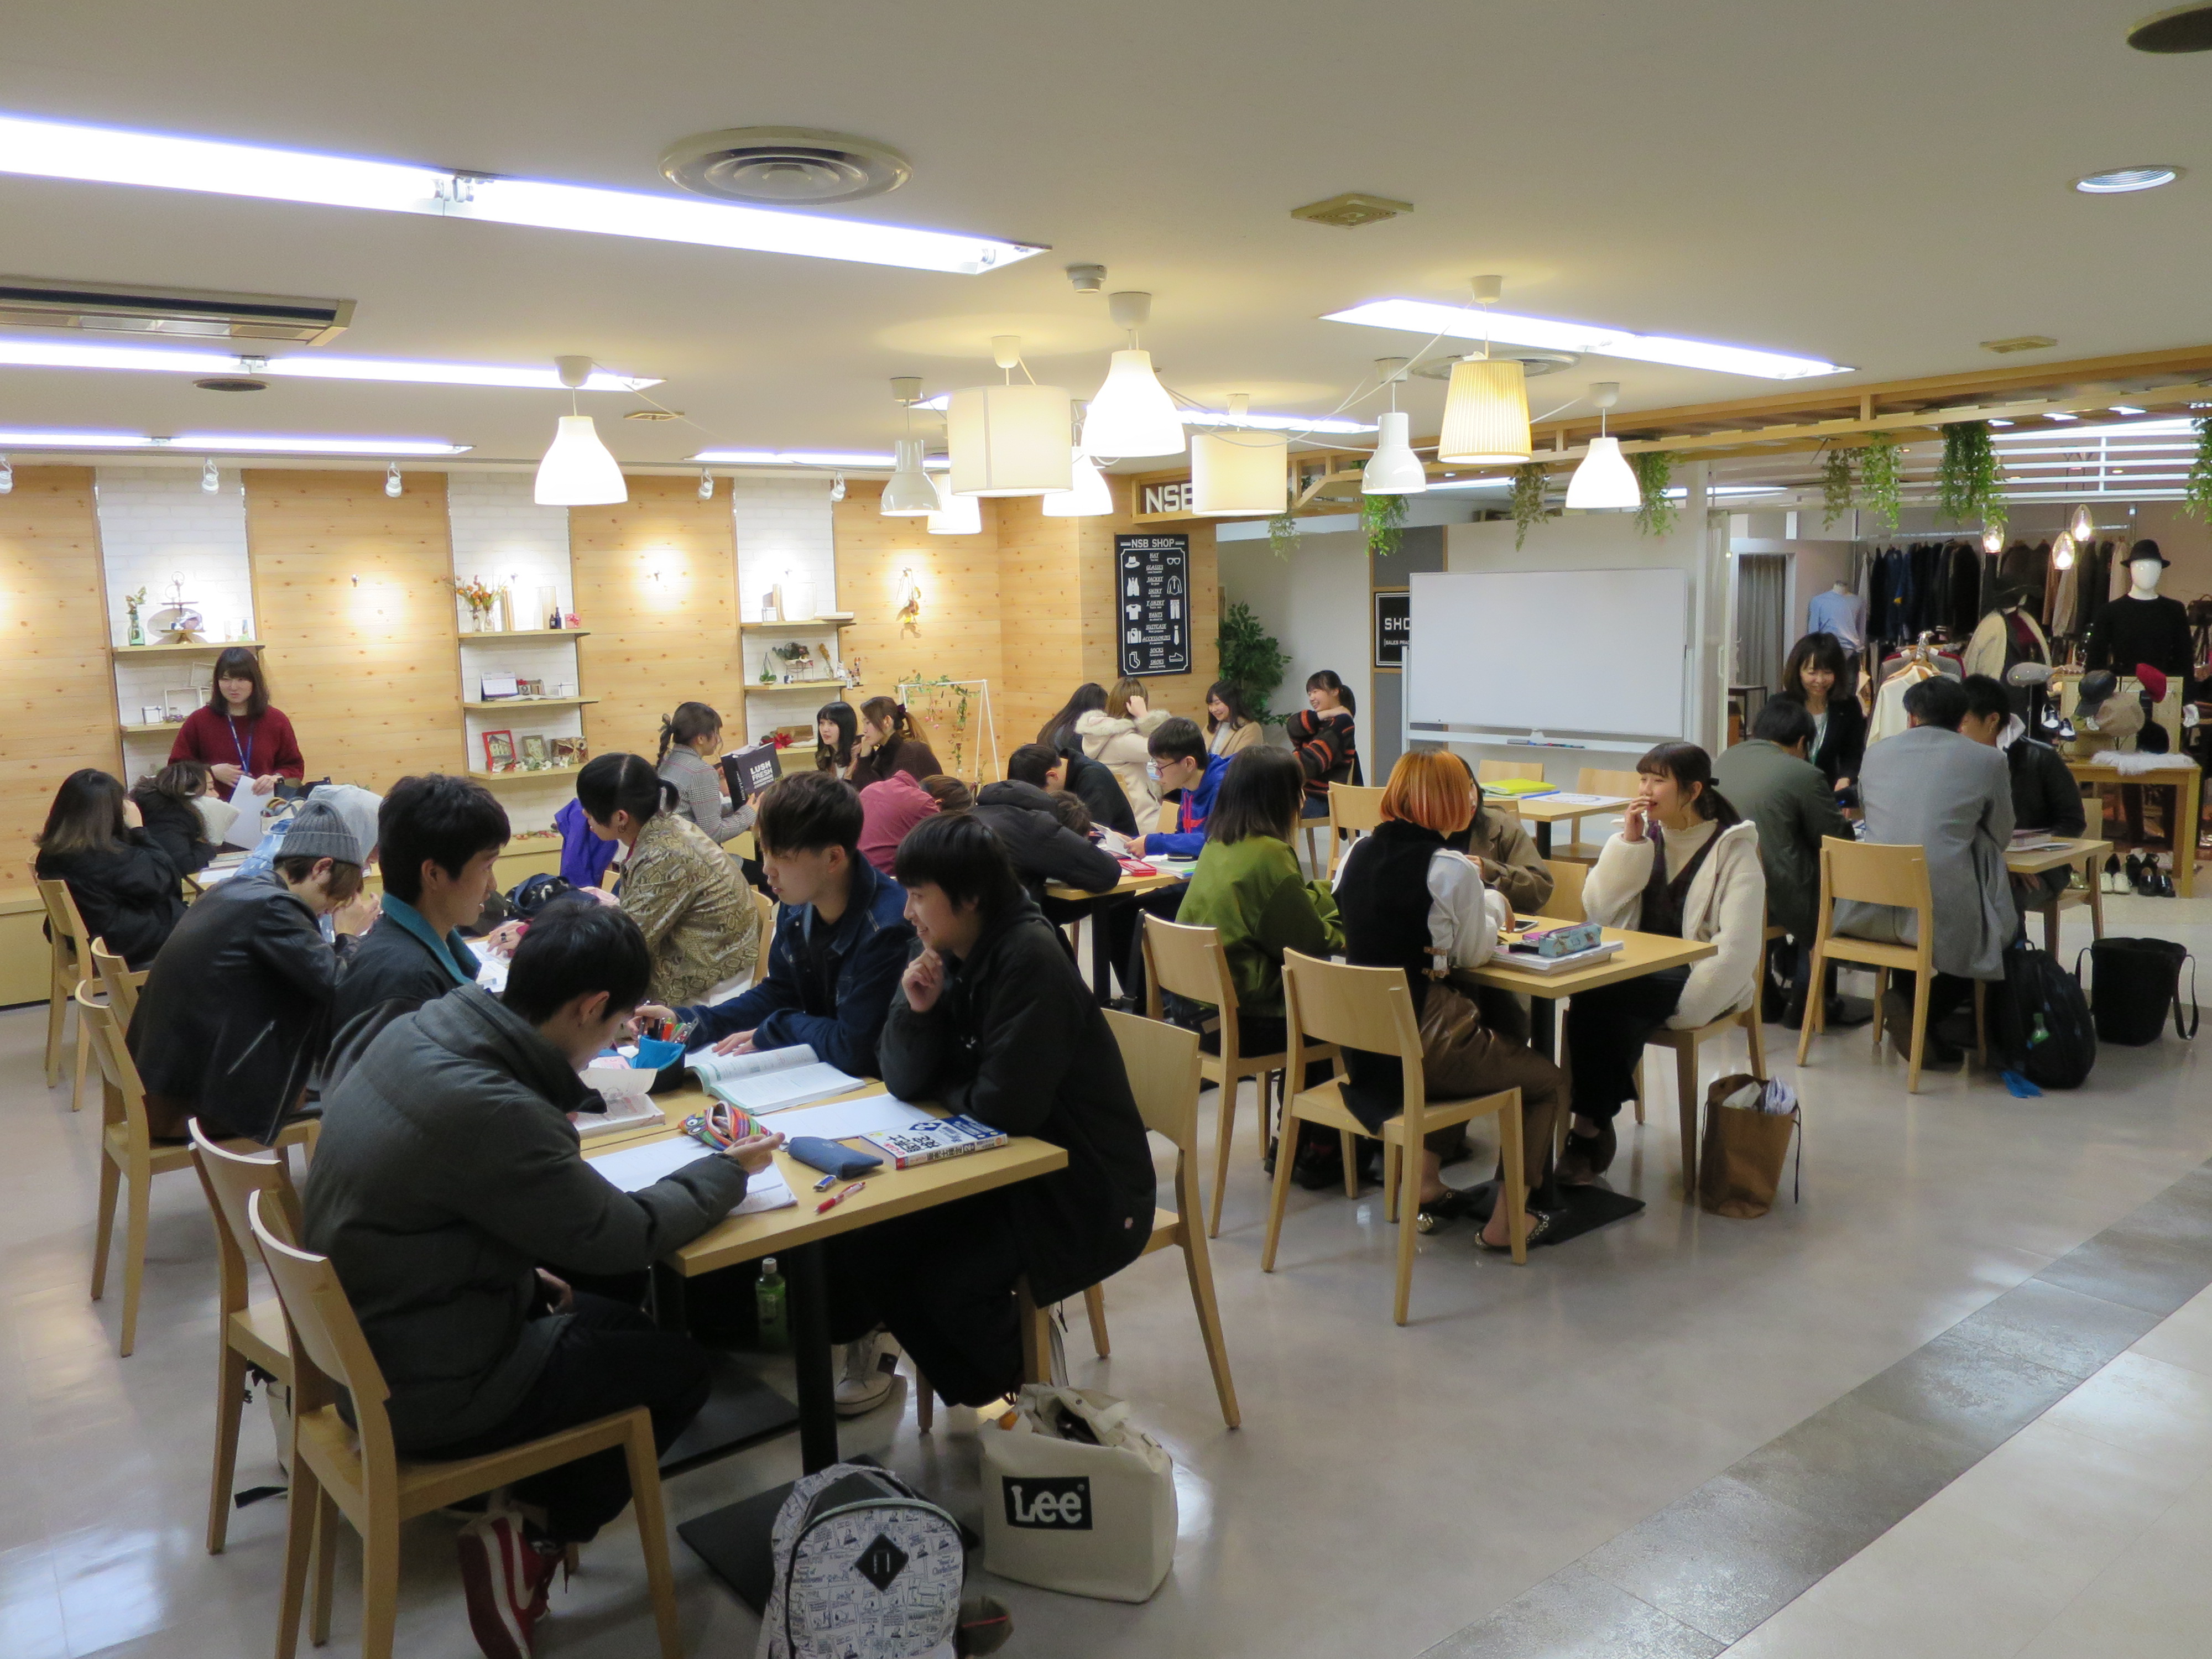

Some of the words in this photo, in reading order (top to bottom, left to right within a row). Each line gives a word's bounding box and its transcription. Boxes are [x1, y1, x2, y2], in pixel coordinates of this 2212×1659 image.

[1131, 539, 1149, 548] NSB
[1152, 538, 1175, 547] SHOP
[750, 760, 771, 775] LUSH
[752, 768, 773, 781] FRESH
[1011, 1485, 1082, 1524] Lee
